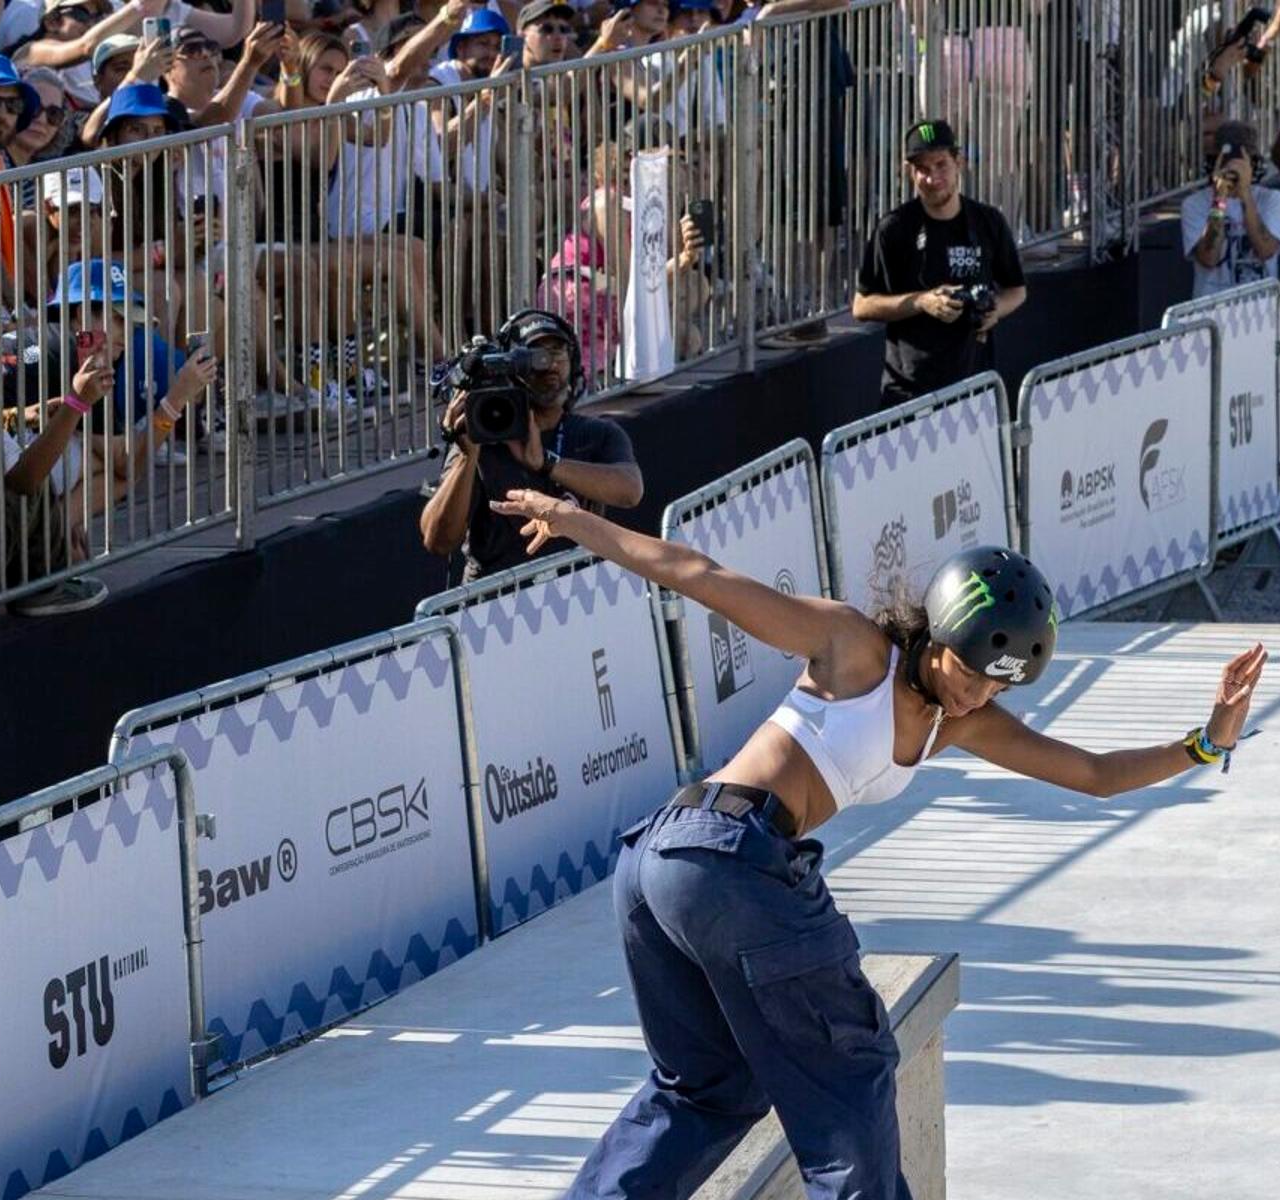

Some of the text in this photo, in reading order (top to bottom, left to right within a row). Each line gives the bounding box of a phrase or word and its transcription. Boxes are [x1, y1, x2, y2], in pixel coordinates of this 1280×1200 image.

[1229, 391, 1252, 449] STU
[1076, 463, 1117, 501] ABPSK
[997, 653, 1028, 671] NIKE
[325, 777, 430, 857] CBSK
[484, 756, 559, 825] Outside
[113, 945, 149, 982] NATIONAL
[43, 953, 116, 1071] STU
